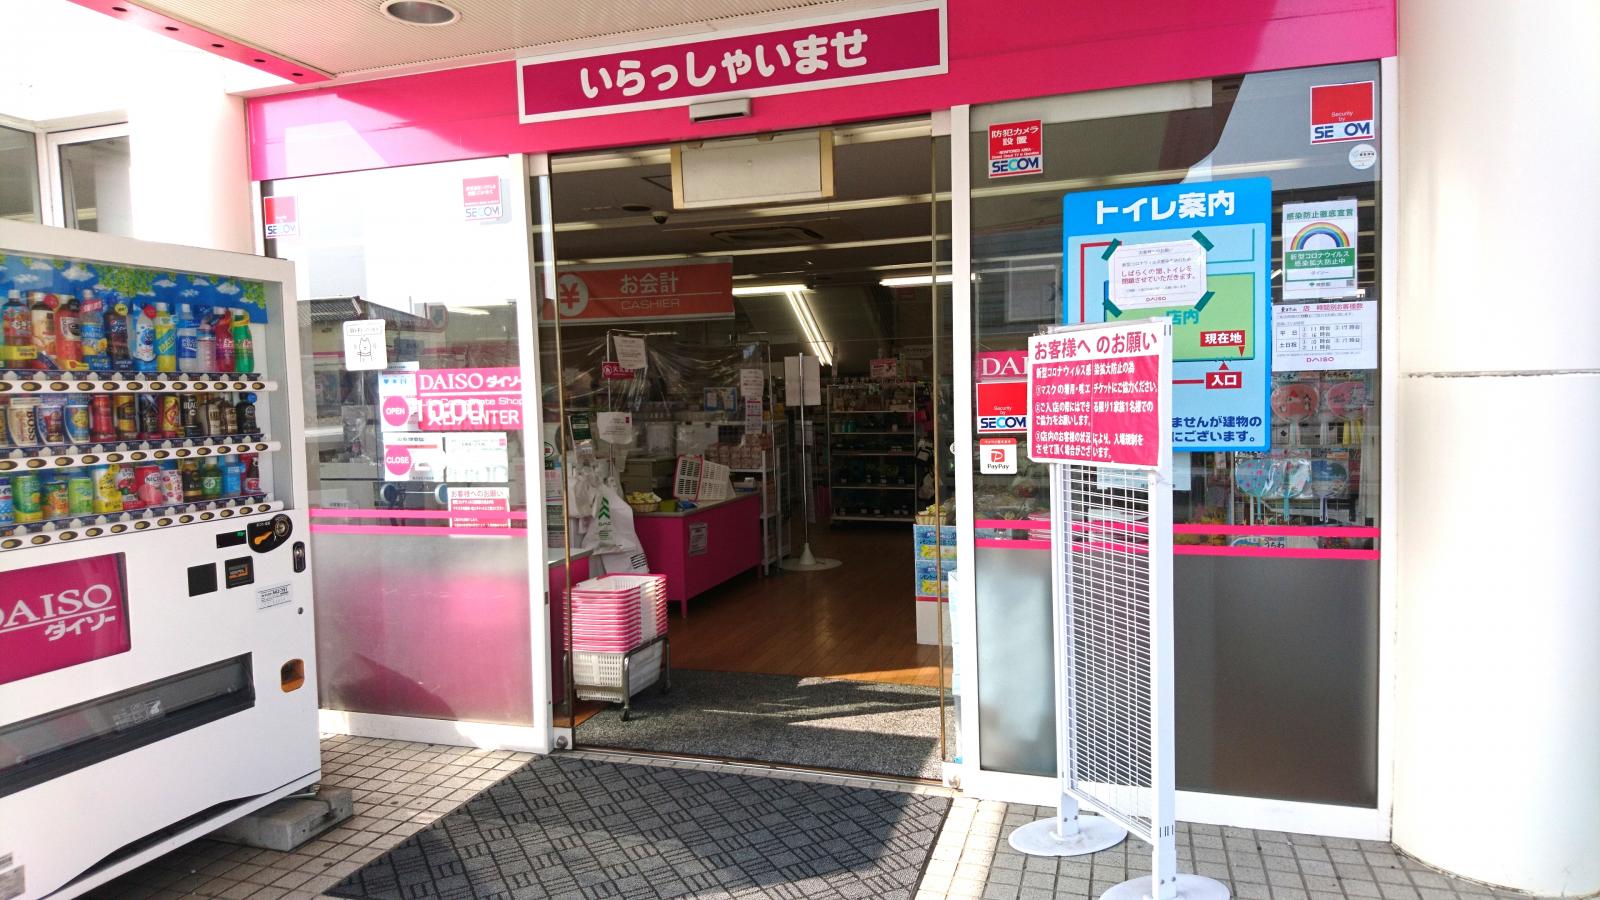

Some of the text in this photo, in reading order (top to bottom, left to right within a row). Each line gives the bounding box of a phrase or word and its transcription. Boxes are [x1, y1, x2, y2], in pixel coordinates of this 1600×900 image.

[580, 28, 868, 99] いらっしゃいませ
[991, 125, 1040, 139] 防犯カメラ
[1314, 122, 1370, 139] SEOM
[1002, 136, 1028, 146] 設置
[992, 157, 1039, 173] SECOM
[1096, 189, 1236, 225] トイレ案内
[1290, 250, 1350, 260] 新型コロナウイルス
[1294, 257, 1346, 267] 感染拡大防止中
[619, 271, 680, 295] お会計
[620, 298, 681, 311] CASHIER
[1166, 309, 1200, 325] 店内
[1204, 331, 1243, 345] 現在地
[1034, 331, 1157, 360] お客様へのお願い
[419, 373, 484, 390] DAISO
[1211, 372, 1238, 386] 入口
[385, 407, 406, 416] OPEN
[26, 411, 36, 441] BOSS
[980, 416, 1027, 429] SECOM
[1036, 414, 1091, 427] ご協力をお願いします。
[1172, 415, 1262, 428] ませんが建物の
[1172, 430, 1256, 443] にございます。
[386, 456, 410, 464] CLOSE
[45, 613, 116, 641] ダイソー
